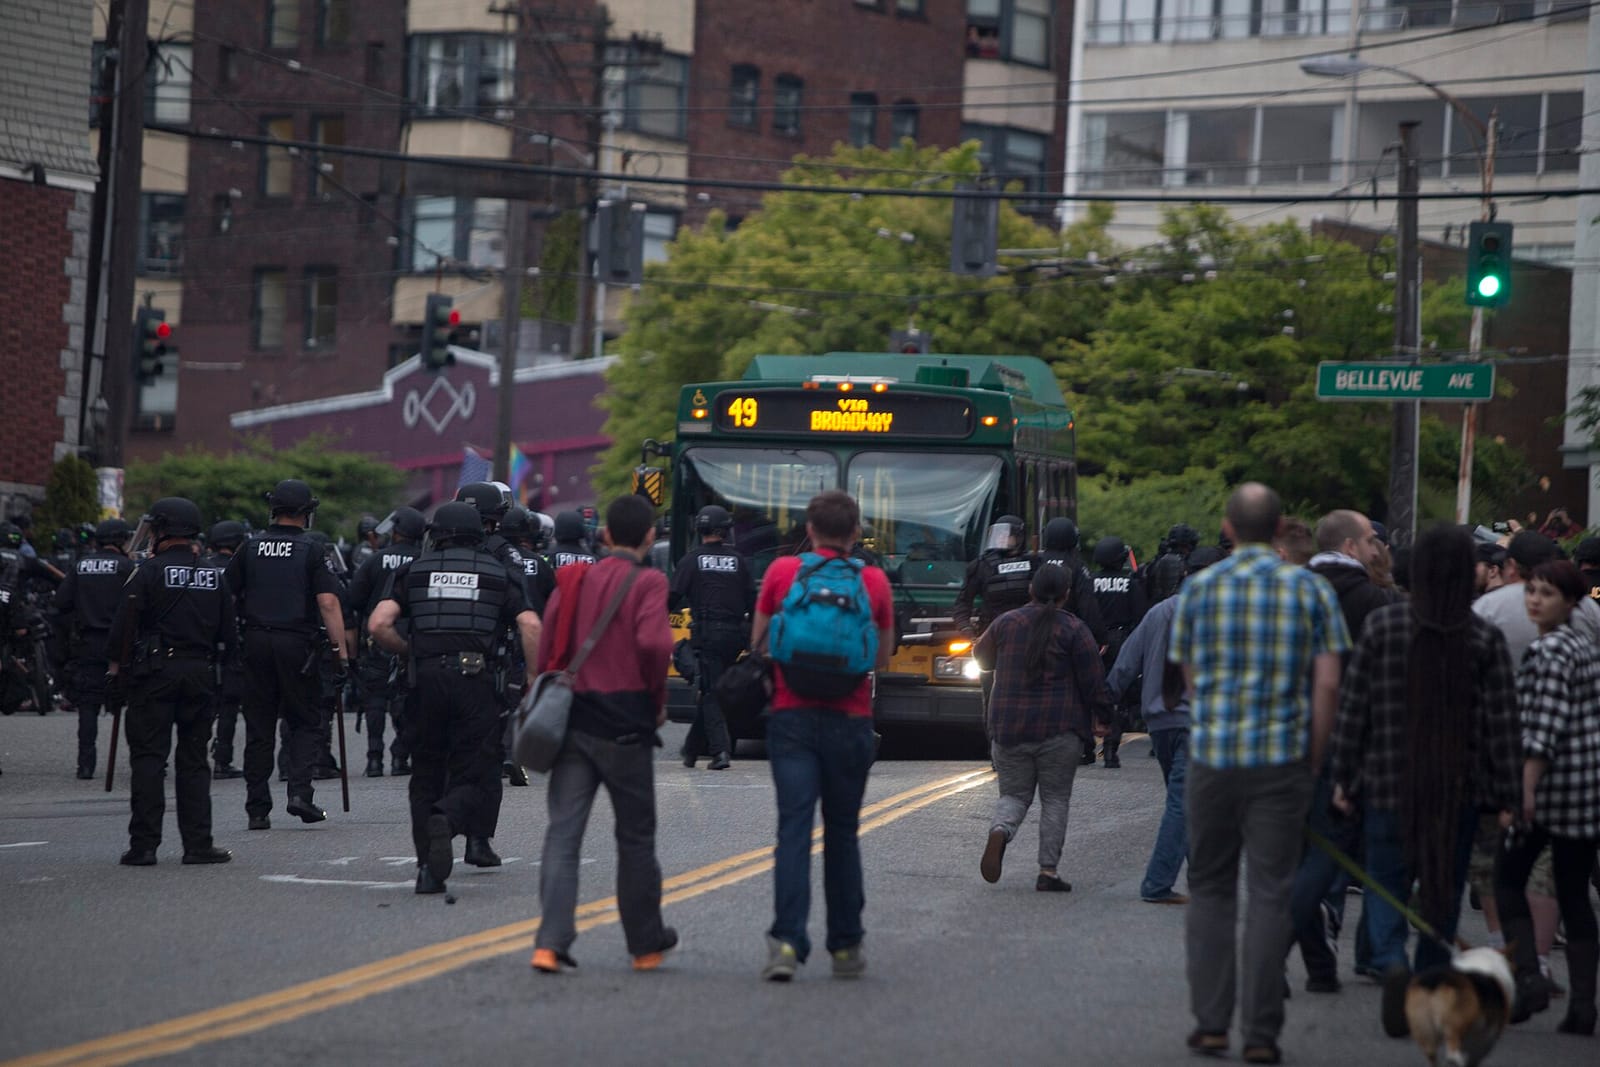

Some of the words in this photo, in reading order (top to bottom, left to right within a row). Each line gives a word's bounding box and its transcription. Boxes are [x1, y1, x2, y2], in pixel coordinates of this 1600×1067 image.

[1335, 370, 1424, 391] BELLEVUE
[1448, 373, 1474, 389] AVE
[728, 397, 758, 428] 49
[838, 399, 868, 411] VIA
[811, 411, 893, 432] BROADWAY
[258, 541, 293, 557] POLICE
[80, 559, 115, 572] POLICE
[382, 554, 414, 569] POLI
[701, 555, 736, 569] POLICE
[1000, 562, 1029, 572] POLICE
[170, 568, 215, 587] POLICE
[432, 574, 475, 586] POLICE
[1093, 576, 1130, 593] POLICE
